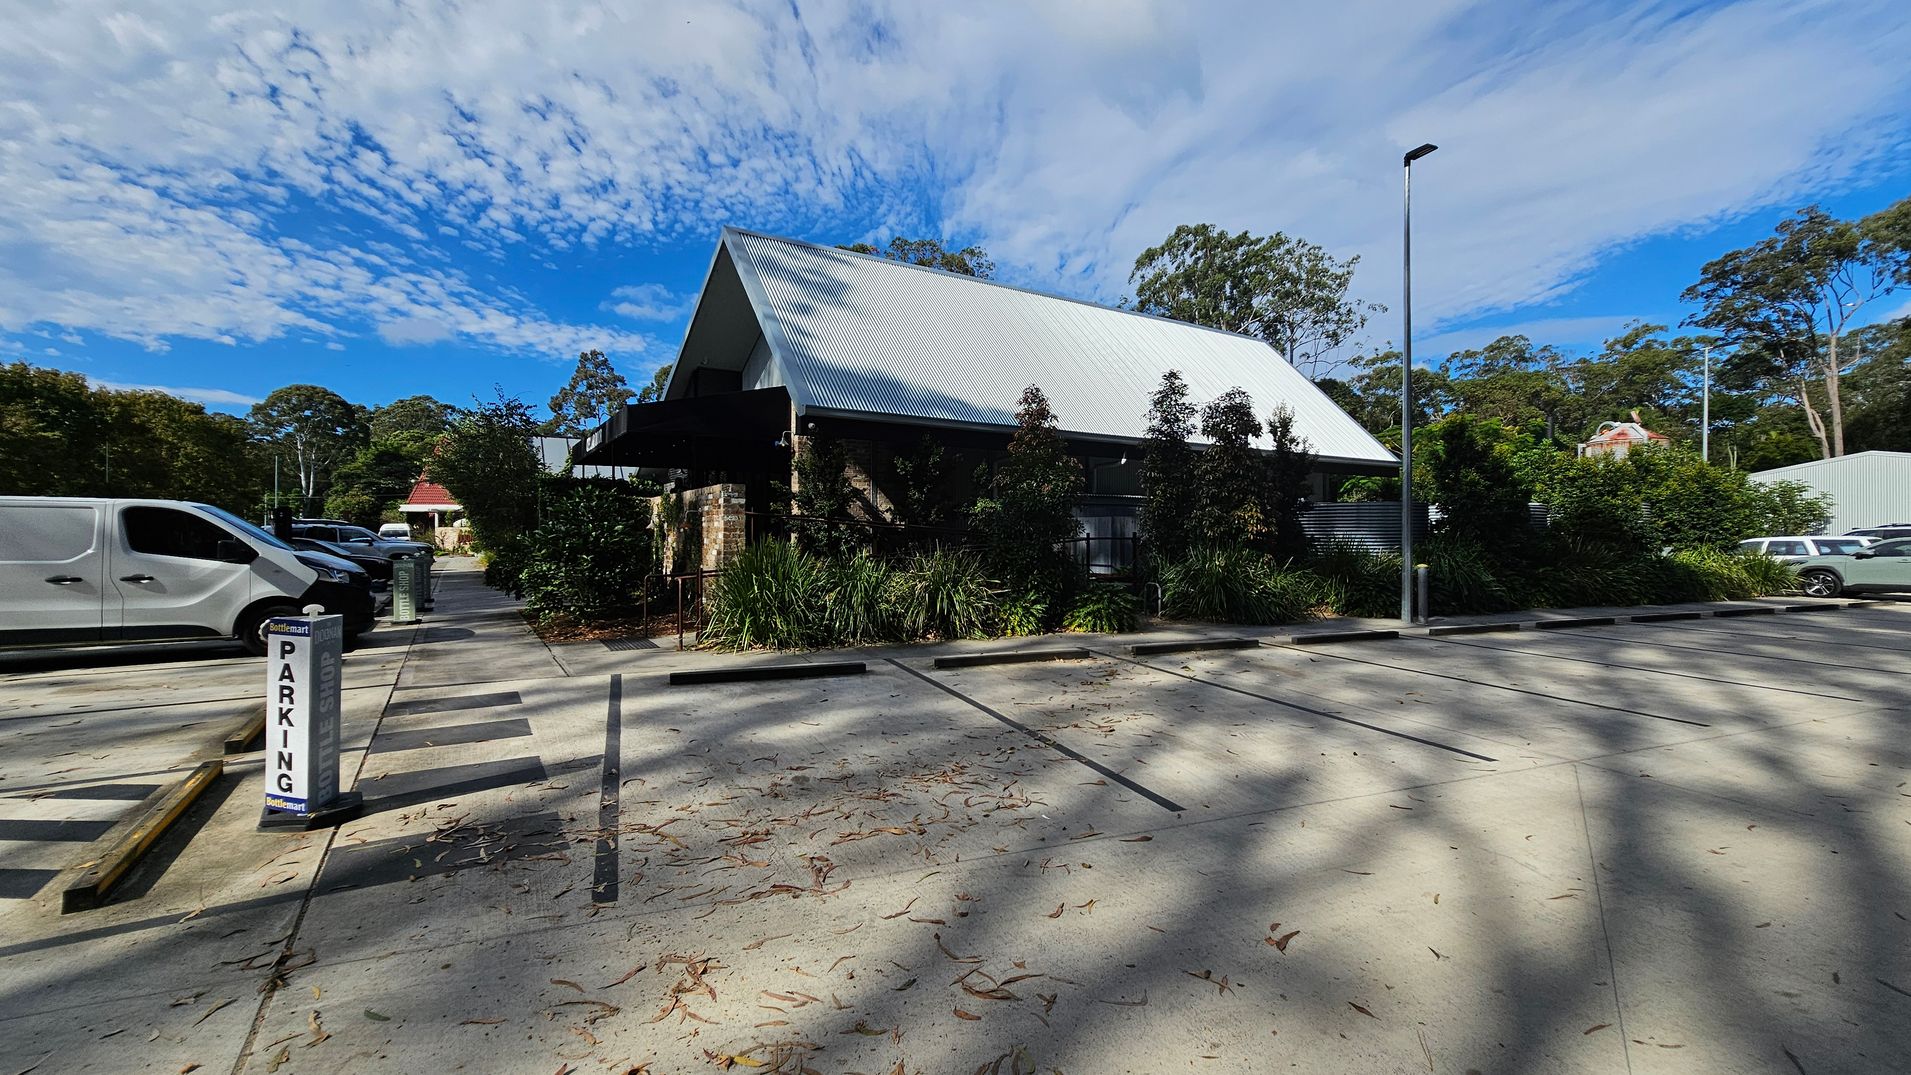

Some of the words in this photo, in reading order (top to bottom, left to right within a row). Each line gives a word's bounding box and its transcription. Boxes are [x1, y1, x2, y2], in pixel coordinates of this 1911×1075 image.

[398, 570, 409, 590] SHOP
[399, 591, 410, 620] BOTTLE
[269, 622, 309, 634] Bottlemart
[319, 651, 335, 713] SHOP
[277, 640, 296, 794] PARKING
[318, 717, 334, 805] BOTTLE
[266, 797, 305, 812] Bottlemart
